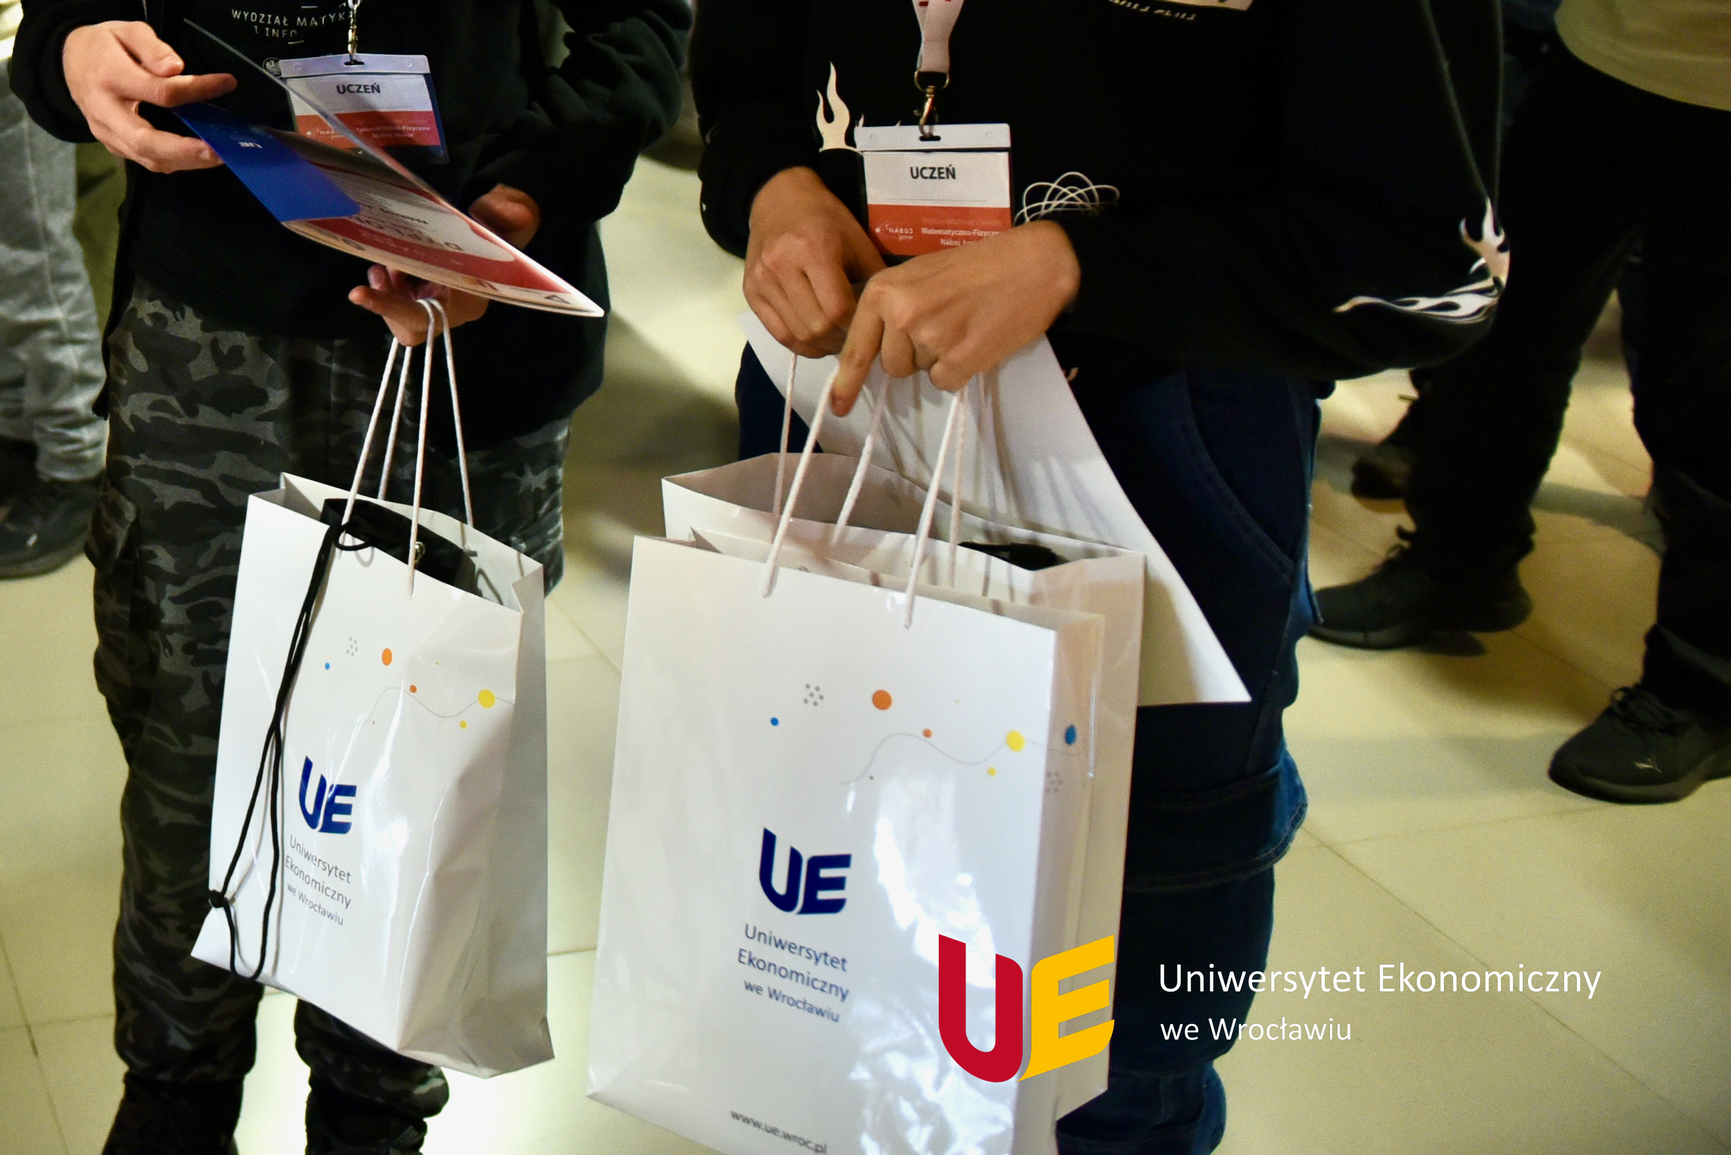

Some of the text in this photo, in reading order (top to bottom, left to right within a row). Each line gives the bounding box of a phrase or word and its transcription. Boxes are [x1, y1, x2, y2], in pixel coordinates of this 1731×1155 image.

[231, 8, 289, 27] WYDZIAŁ
[336, 82, 381, 95] UCZEŃ
[910, 164, 956, 180] UCZEŃ
[299, 755, 357, 833] UE
[285, 855, 352, 909] Ekonomiczny
[289, 834, 352, 884] Uniwersytet
[759, 827, 852, 915] UE
[287, 882, 344, 925] we Wrocławiu
[744, 922, 849, 973] Uniwersytet
[737, 948, 850, 1002] Ekonomiczny
[744, 981, 840, 1024] we Wrocławiu
[730, 1110, 827, 1154] www.ue.wroc.pl
